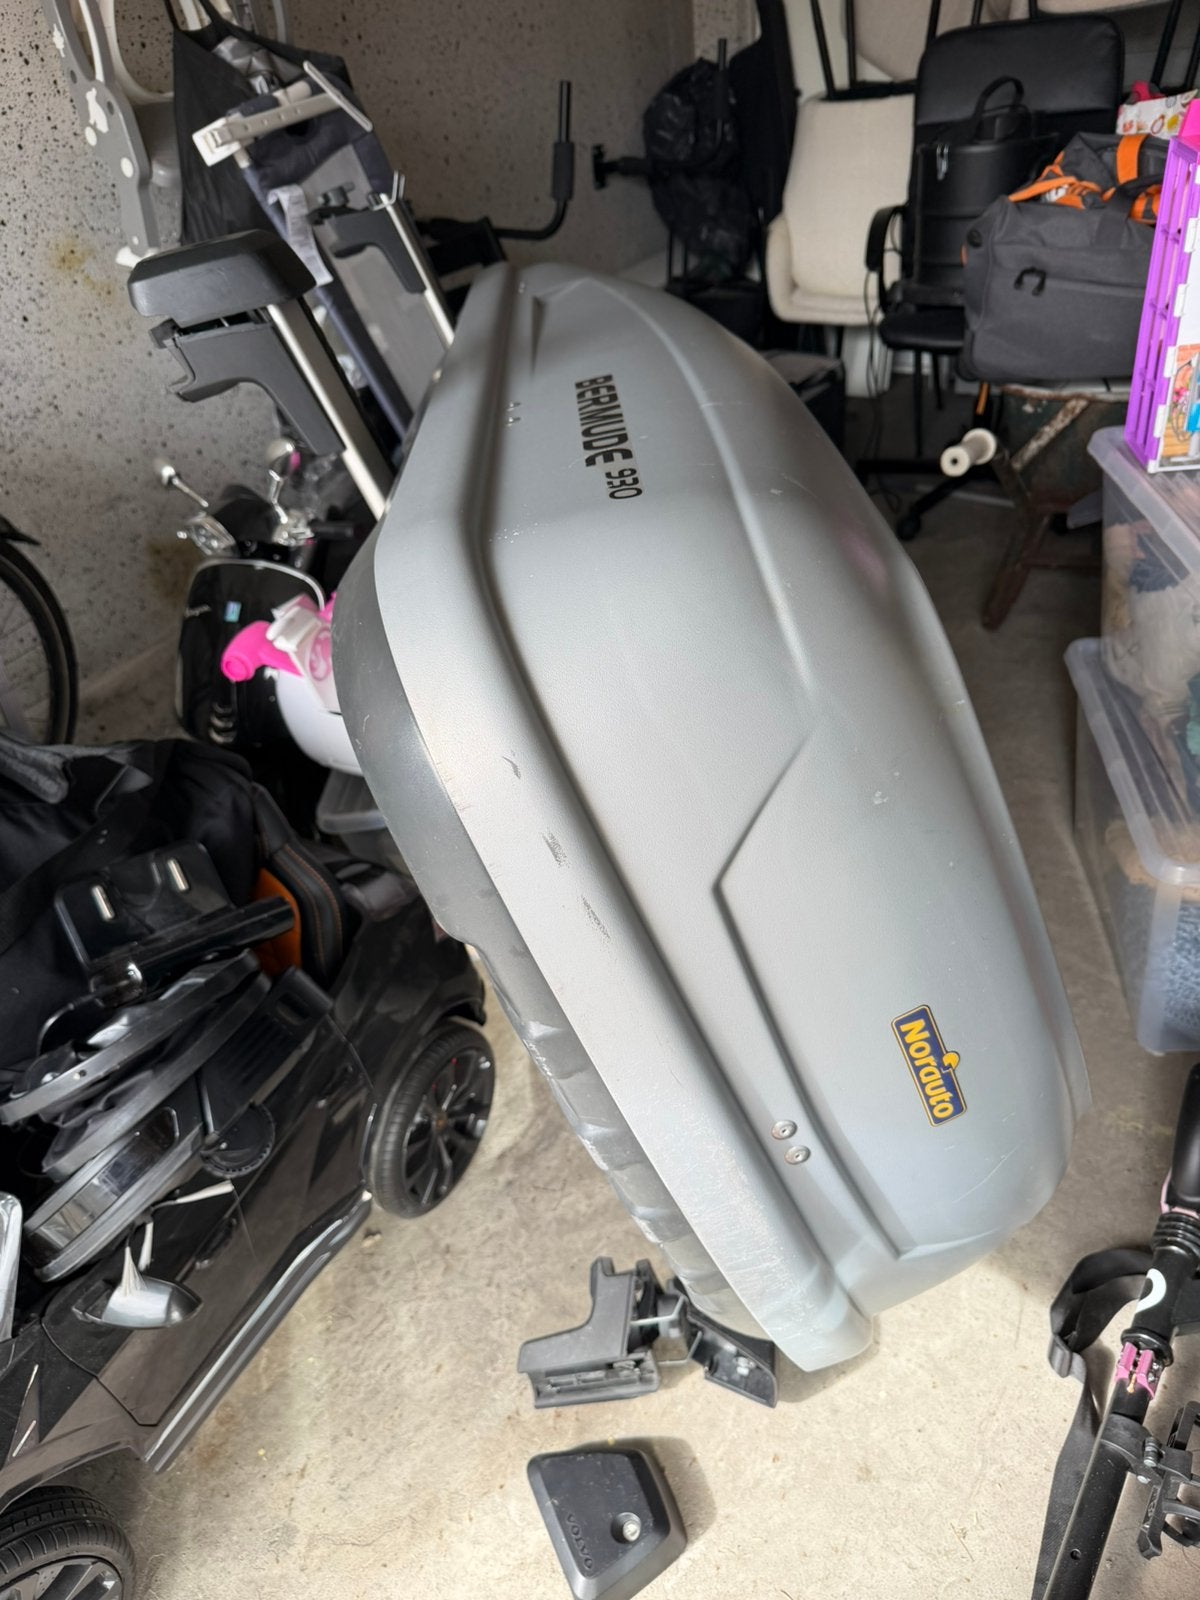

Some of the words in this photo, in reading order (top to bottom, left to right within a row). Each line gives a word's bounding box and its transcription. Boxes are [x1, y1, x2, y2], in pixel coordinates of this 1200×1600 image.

[575, 374, 633, 467] BERMUDE
[605, 468, 643, 500] 930
[899, 1018, 954, 1119] Norauto
[567, 1512, 594, 1571] VOLVO
